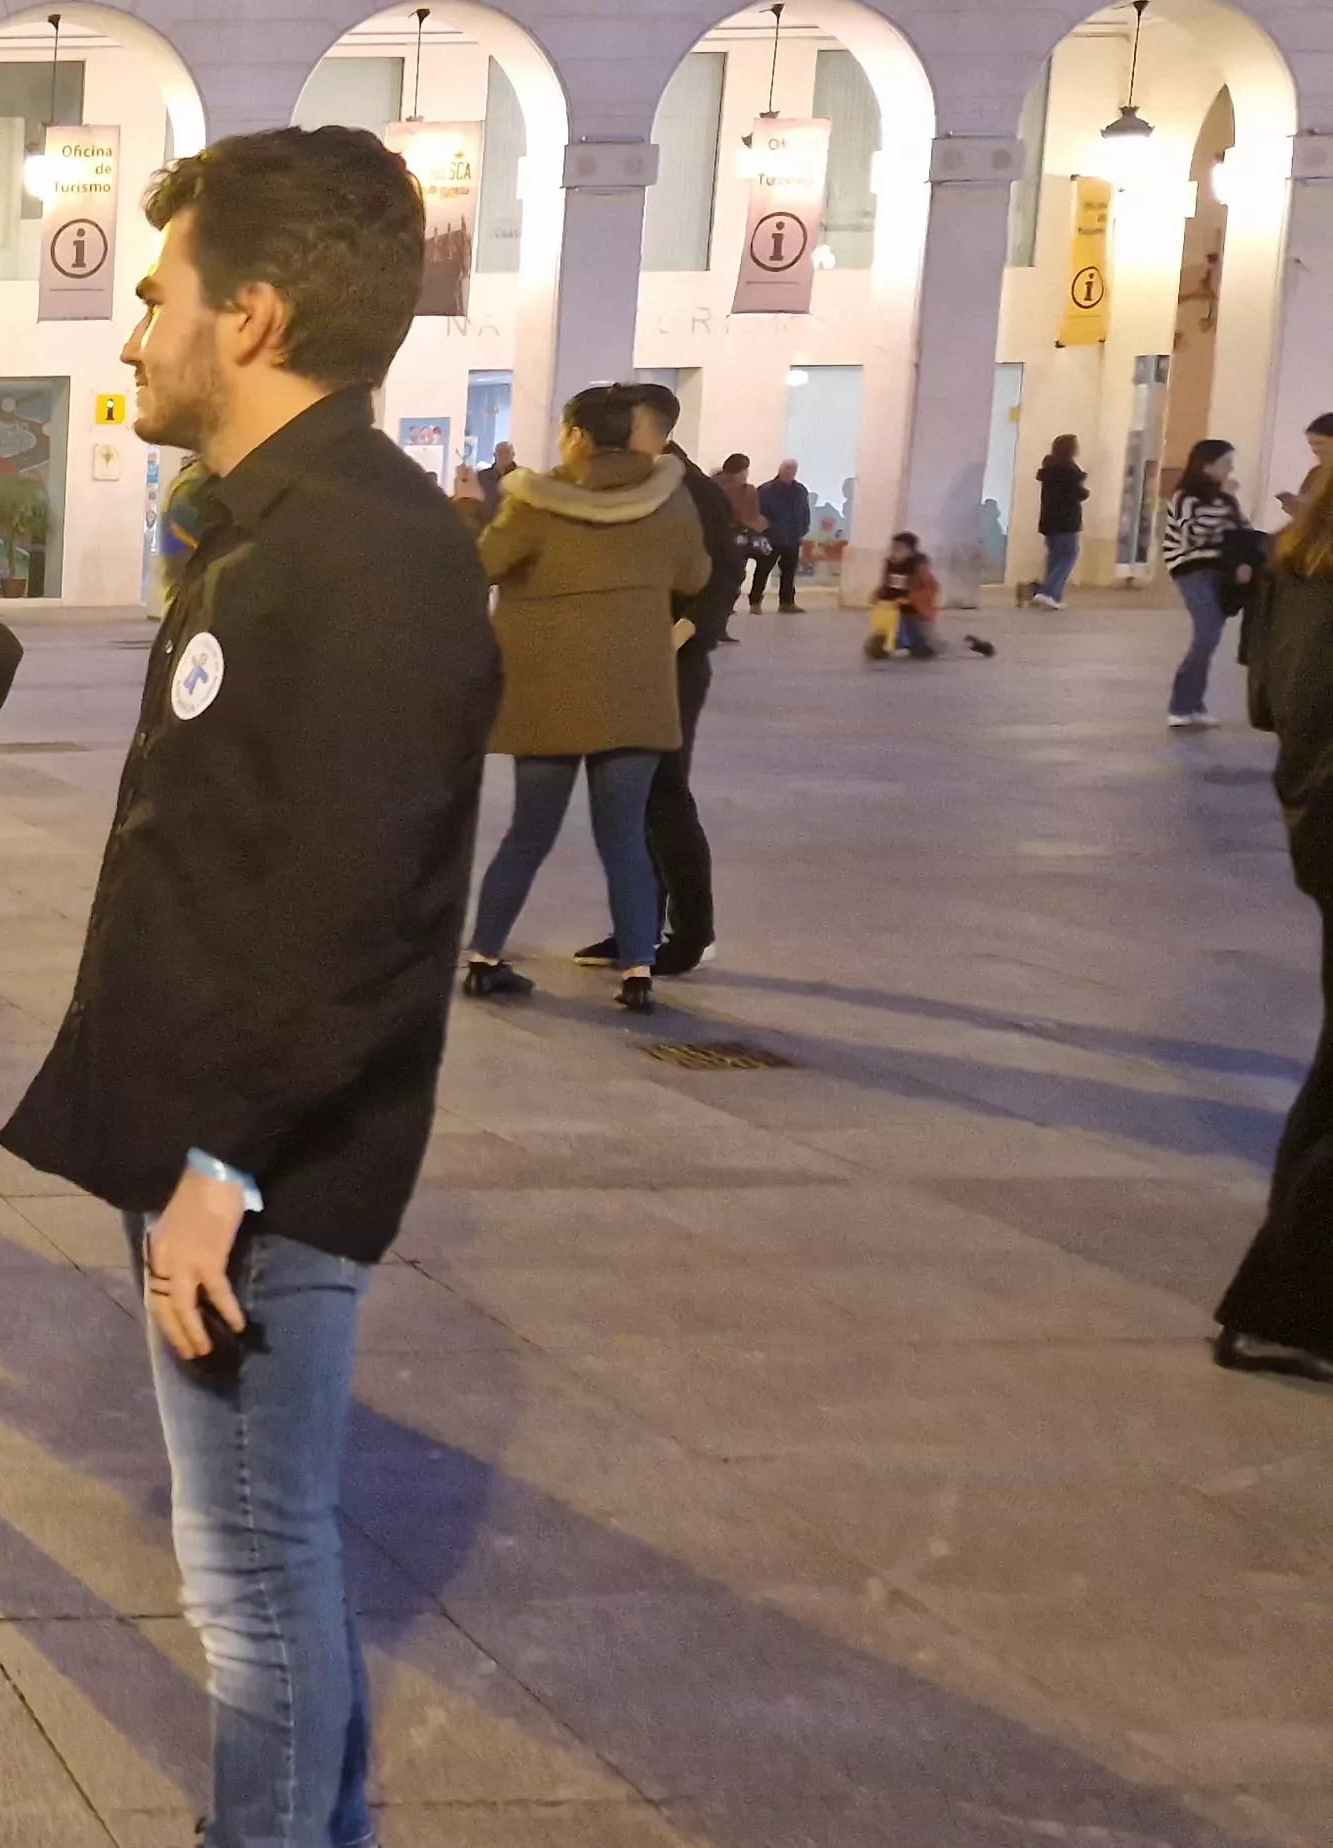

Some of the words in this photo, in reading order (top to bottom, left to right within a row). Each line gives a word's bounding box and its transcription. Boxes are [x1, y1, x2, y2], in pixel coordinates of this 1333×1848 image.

[62, 144, 112, 158] Oficina
[95, 163, 112, 175] de
[54, 181, 111, 193] Turismo
